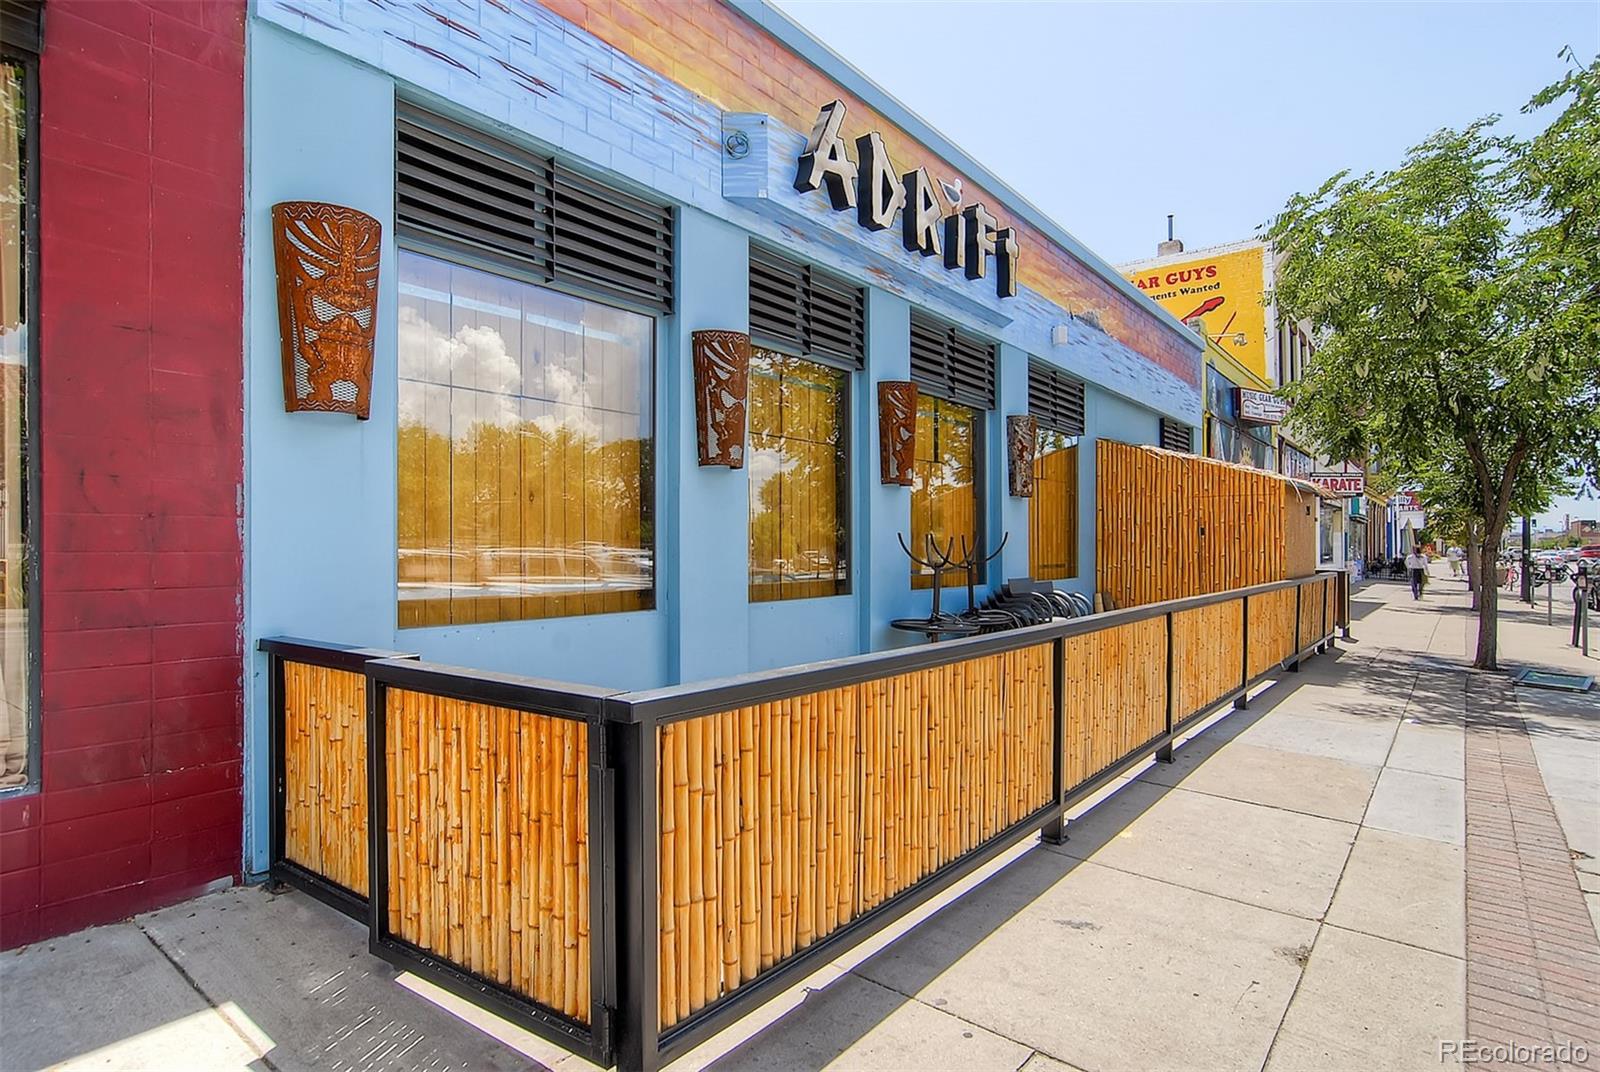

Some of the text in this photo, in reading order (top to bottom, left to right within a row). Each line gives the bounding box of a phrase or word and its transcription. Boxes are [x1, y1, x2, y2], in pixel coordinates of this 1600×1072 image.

[794, 99, 1019, 298] ADRIFT
[1132, 265, 1217, 290] AR GUYS
[1179, 281, 1221, 296] Wanted
[1259, 393, 1271, 402] GEAR
[1312, 478, 1361, 491] KARATE
